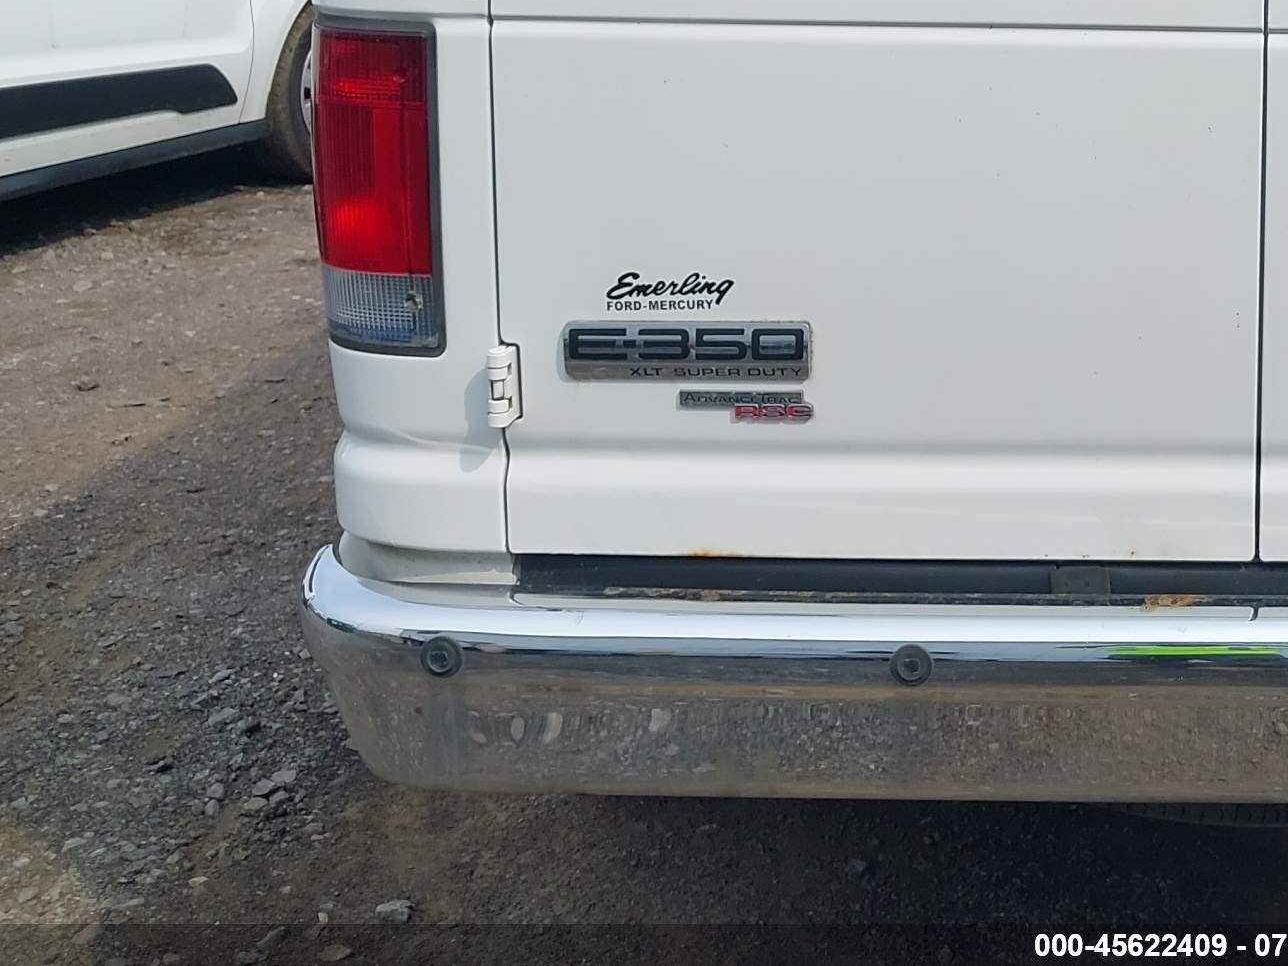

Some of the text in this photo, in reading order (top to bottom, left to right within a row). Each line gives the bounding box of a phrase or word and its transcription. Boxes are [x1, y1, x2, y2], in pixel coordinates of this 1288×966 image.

[606, 271, 735, 306] Emerling
[568, 327, 805, 361] E-350
[629, 367, 802, 377] XLT SUPER DUTY
[734, 403, 814, 420] RSC
